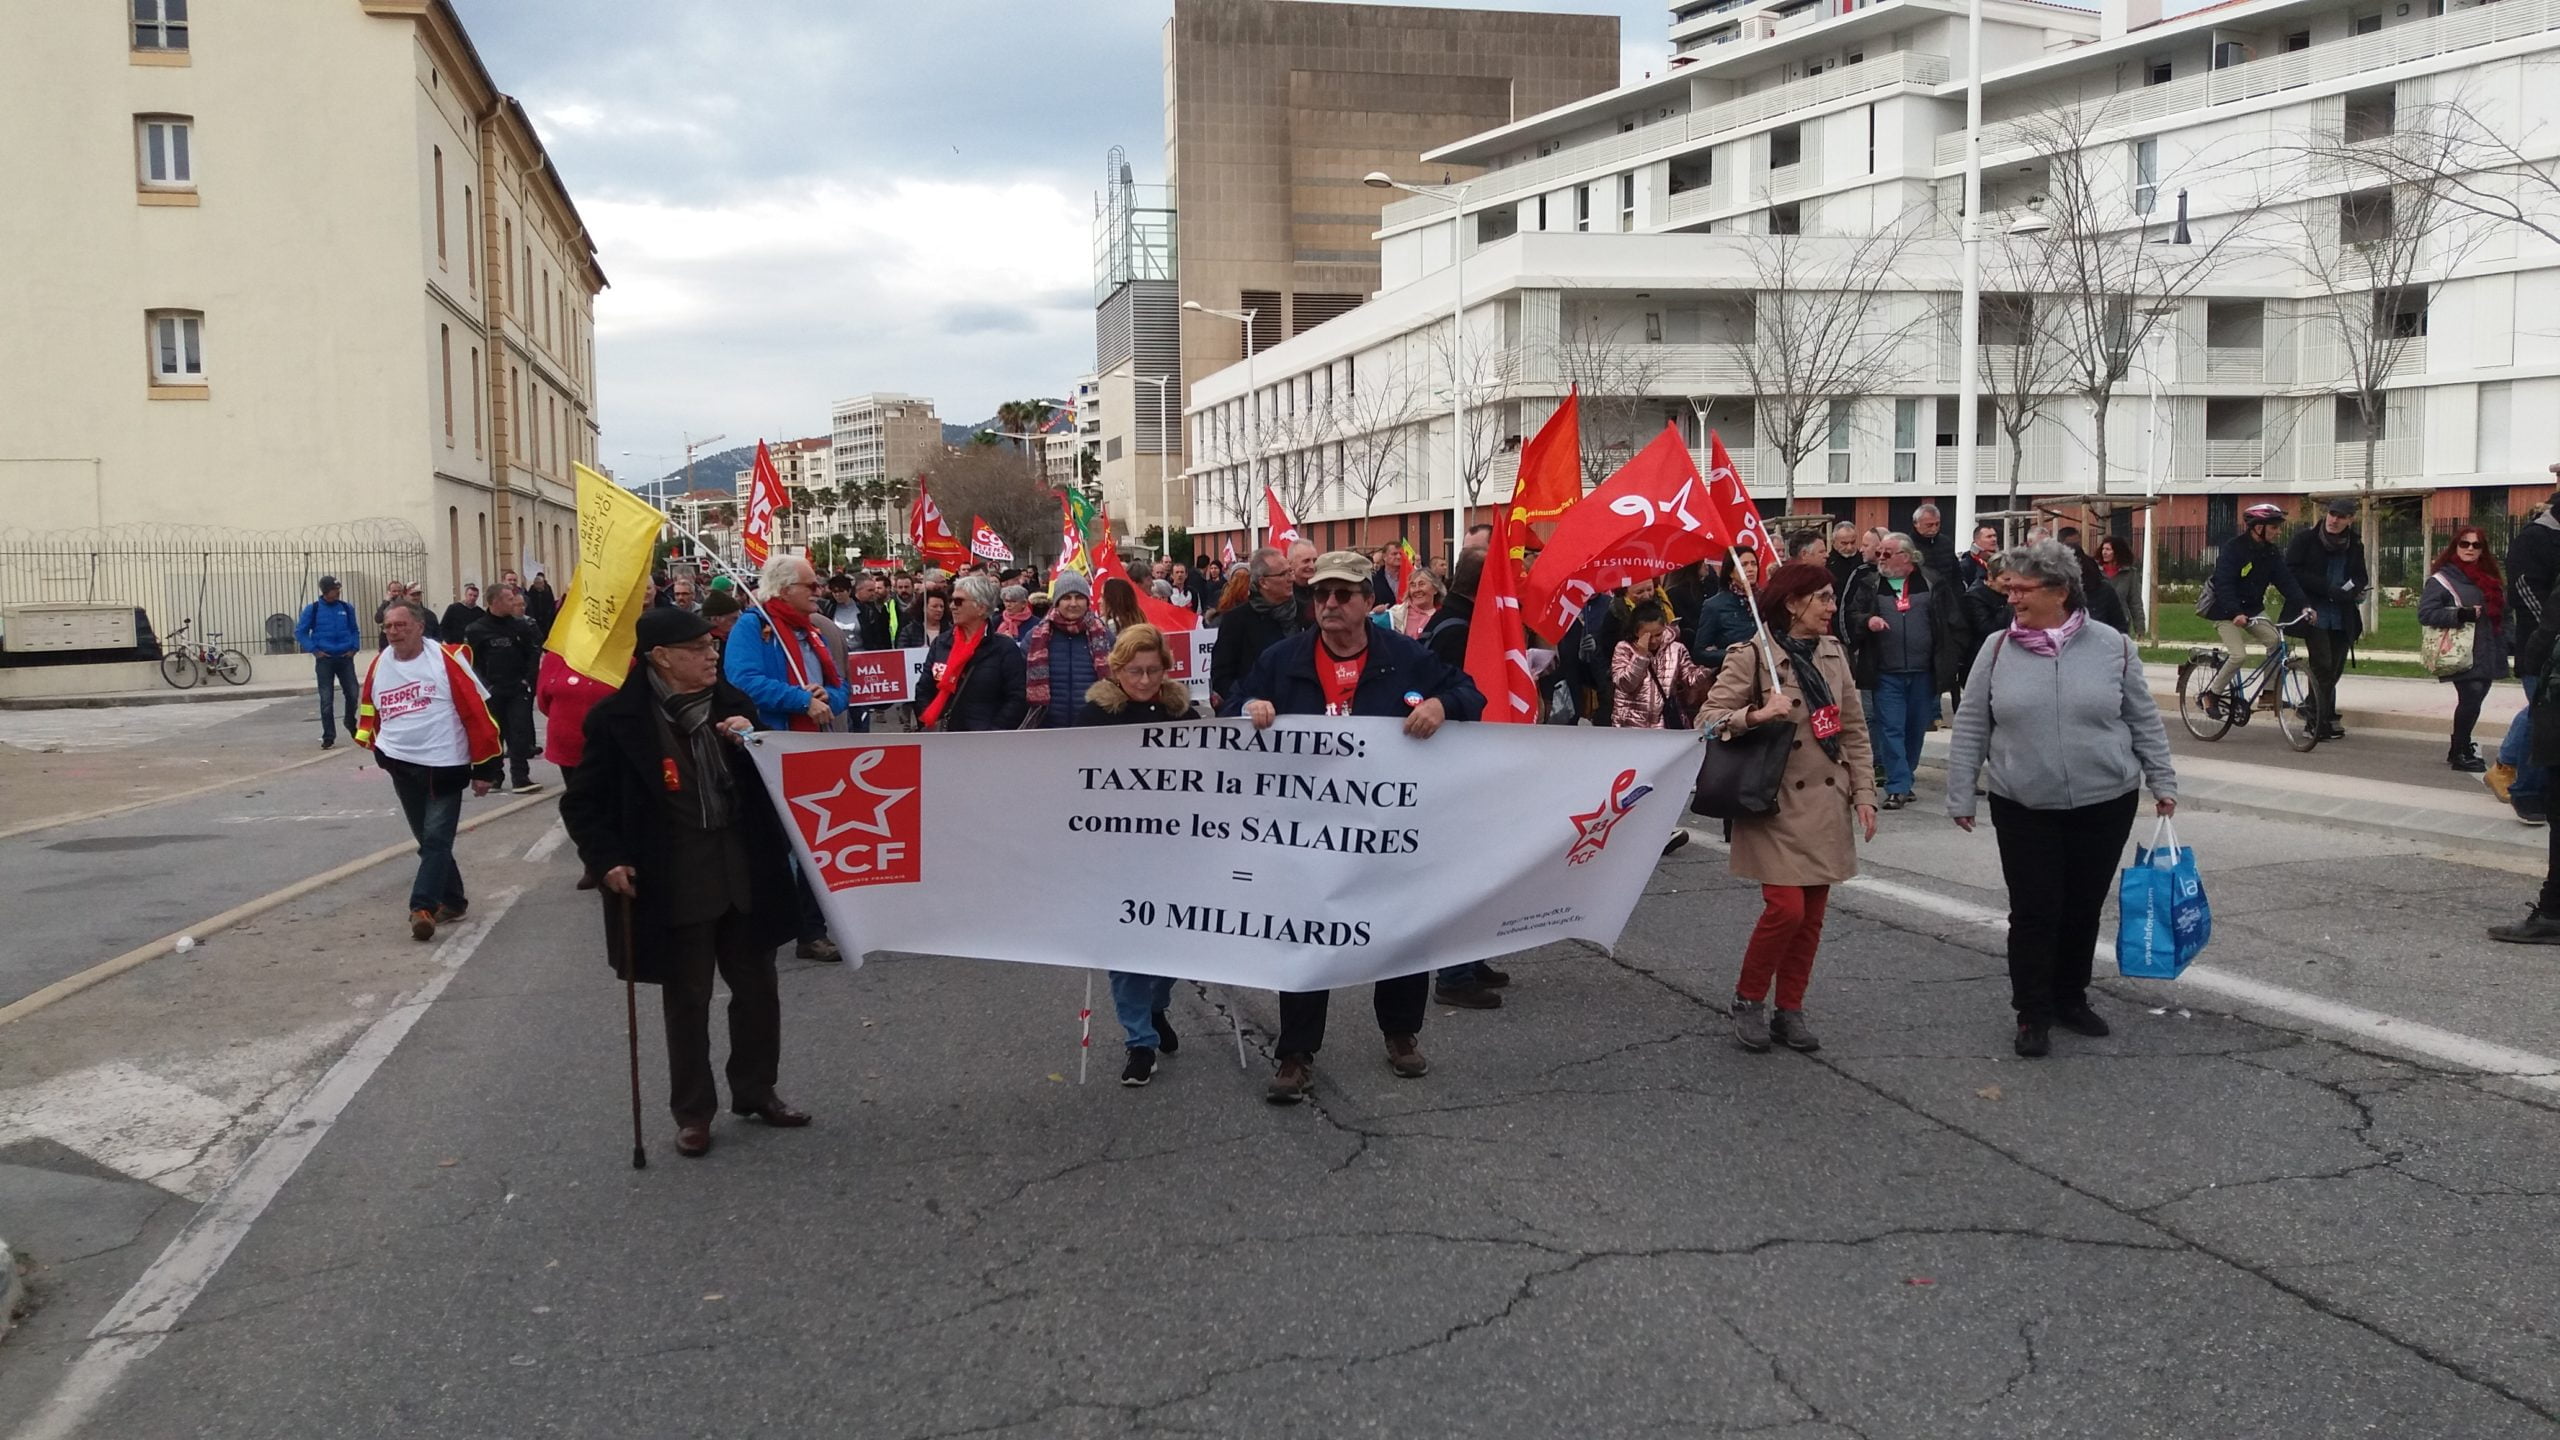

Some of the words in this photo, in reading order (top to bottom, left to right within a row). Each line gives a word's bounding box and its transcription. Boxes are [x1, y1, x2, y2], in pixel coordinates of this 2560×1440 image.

[974, 547, 1011, 559] TOULON
[856, 664, 885, 676] MAL
[380, 685, 421, 707] RESPECT
[1140, 726, 1366, 758] RETRAITES:
[1079, 768, 1204, 793] TAXER
[1216, 771, 1242, 795] la
[1255, 773, 1419, 808] FINANCE
[1068, 813, 1180, 836] comme
[1191, 814, 1230, 839] les
[1241, 816, 1420, 854] SALAIRES
[1589, 818, 1609, 835] 83
[811, 842, 906, 873] PCF
[1567, 850, 1597, 867] PCF
[2179, 876, 2199, 897] la
[1119, 899, 1156, 926] 30
[1166, 903, 1371, 947] MILLIARDS
